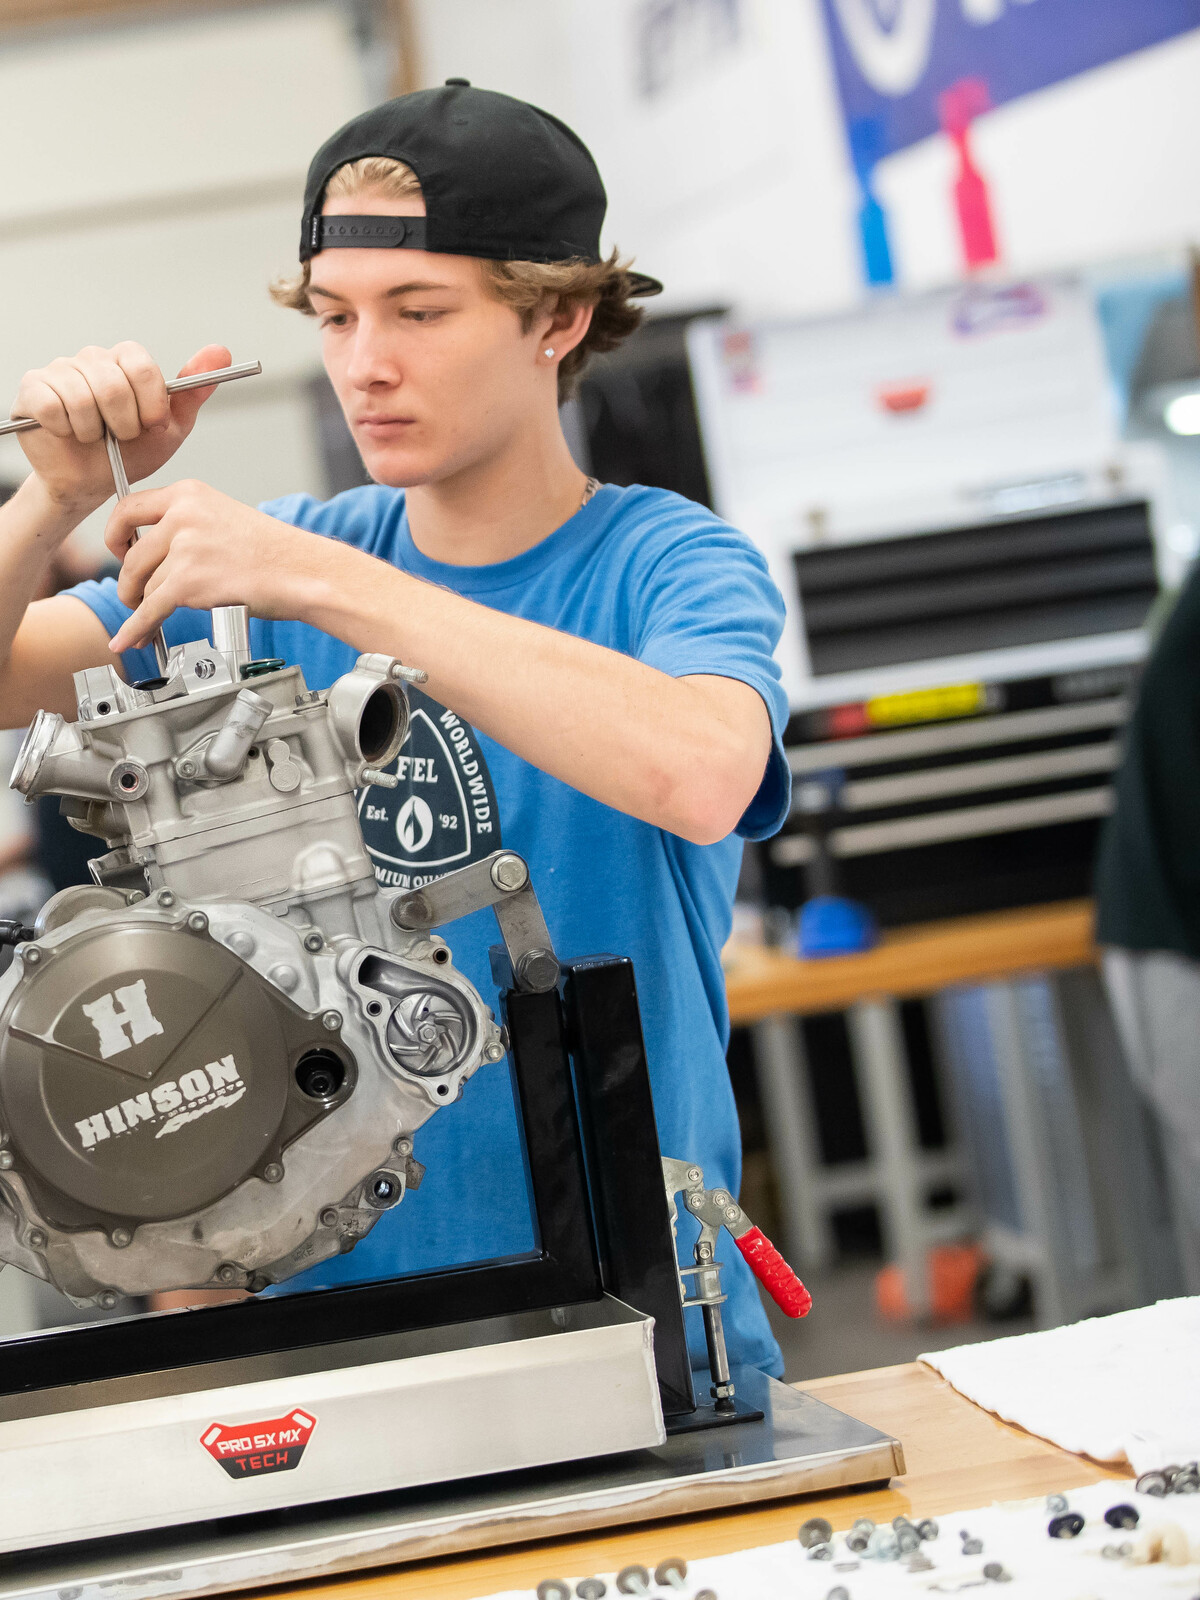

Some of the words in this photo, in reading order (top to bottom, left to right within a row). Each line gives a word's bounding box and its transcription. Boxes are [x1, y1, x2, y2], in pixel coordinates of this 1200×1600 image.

[440, 709, 493, 834] WORLDWIDE
[365, 805, 389, 821] Est.
[82, 978, 165, 1060] H
[74, 1054, 241, 1148] HINSON
[216, 1437, 253, 1454] PRO
[253, 1432, 276, 1449] SX
[279, 1428, 302, 1444] MX
[235, 1451, 289, 1471] TECH
